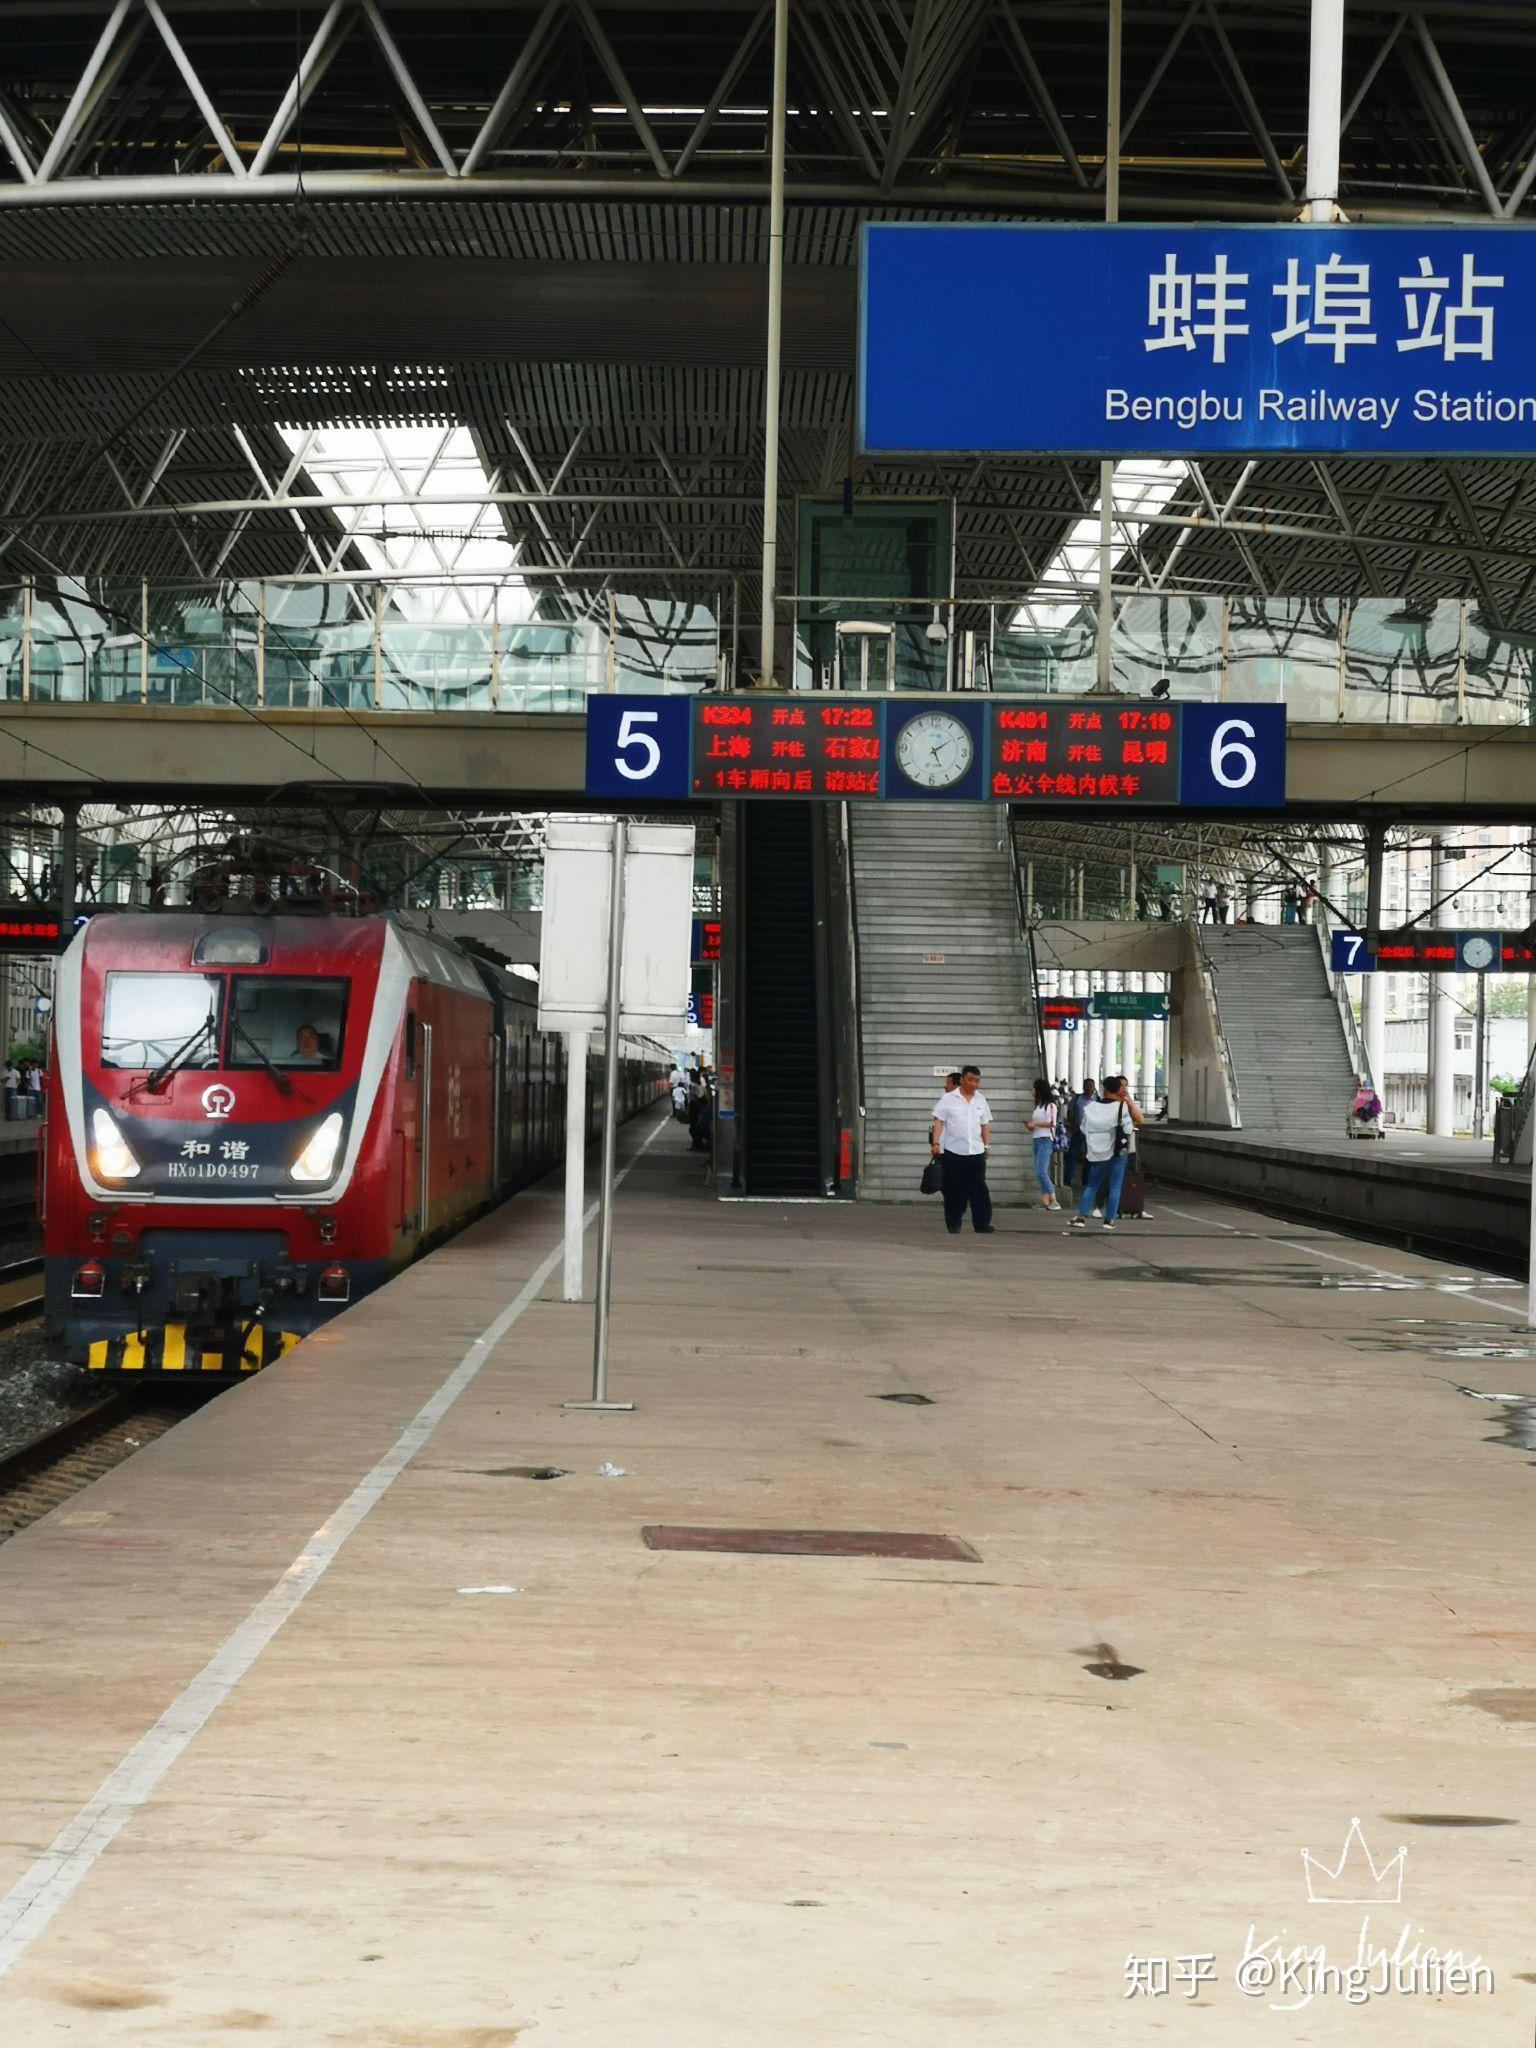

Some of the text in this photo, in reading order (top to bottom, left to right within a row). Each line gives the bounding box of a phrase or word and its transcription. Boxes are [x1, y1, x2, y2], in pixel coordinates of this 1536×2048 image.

[1143, 252, 1505, 363] 蚌埠站
[1105, 388, 1536, 429] Bengbu Railway Station
[702, 706, 873, 726] K234 开点 17:22
[1000, 711, 1172, 731] K491 开点 17:19
[614, 711, 661, 780] 5
[705, 734, 751, 758] 上海
[1001, 738, 1168, 764] 济南 开往 昆明
[1210, 719, 1257, 789] 6
[1343, 936, 1363, 966] 7
[180, 1140, 250, 1160] 和谐
